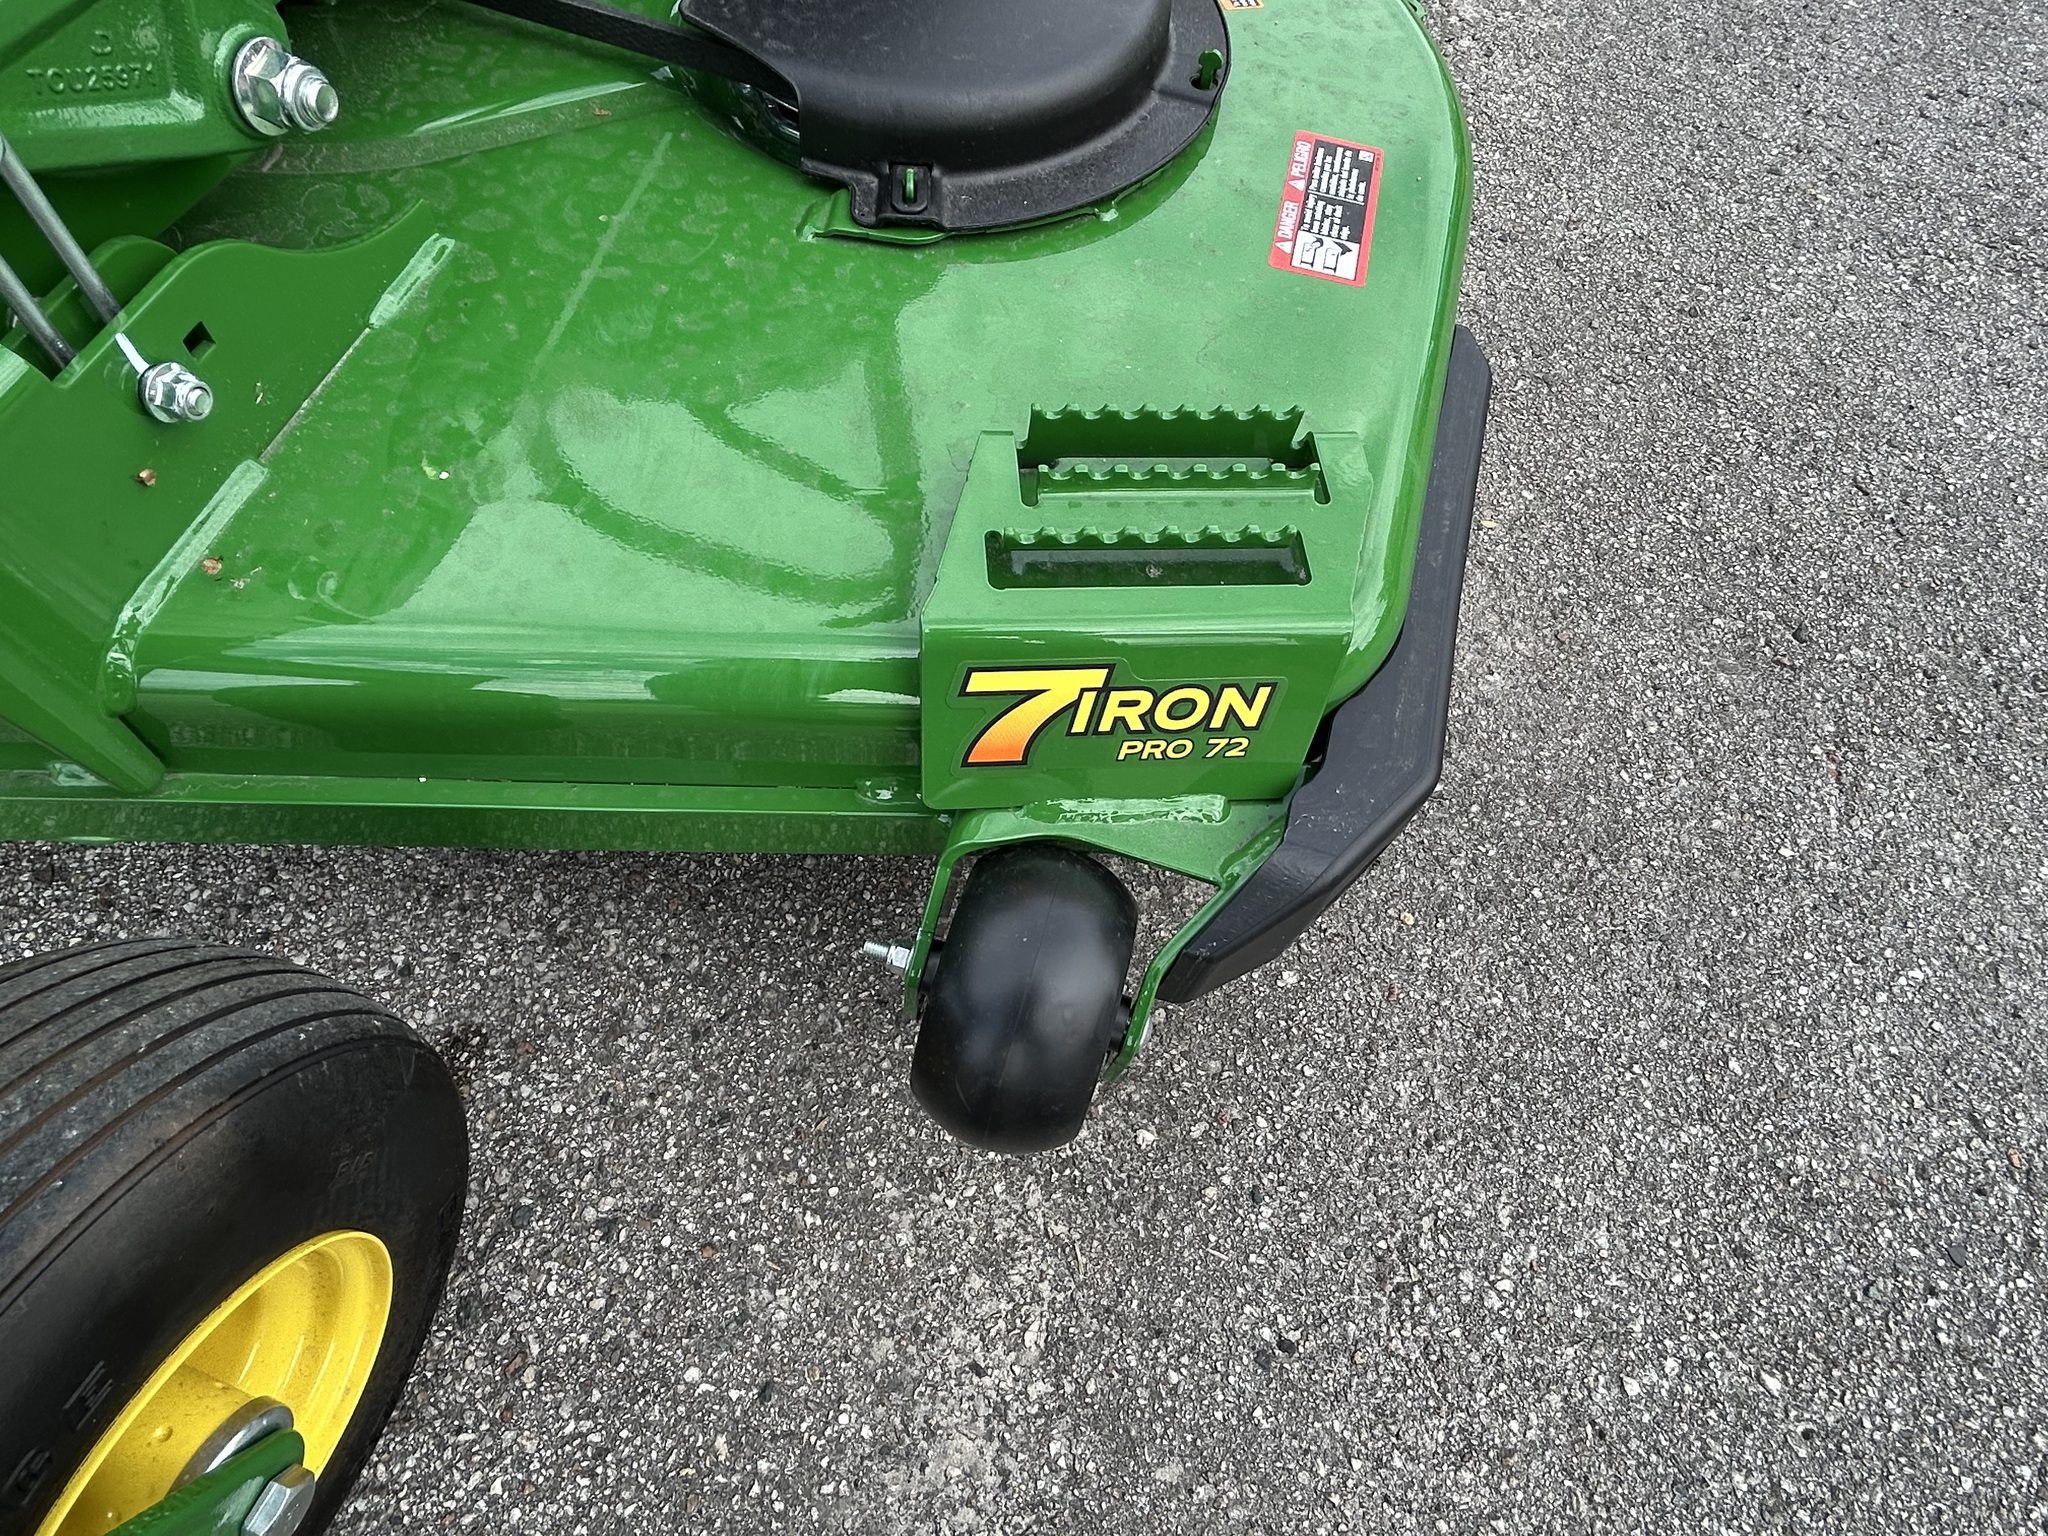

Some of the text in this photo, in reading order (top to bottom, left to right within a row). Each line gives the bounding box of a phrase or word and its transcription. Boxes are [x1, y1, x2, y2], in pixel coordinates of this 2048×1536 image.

[1290, 140, 1311, 178] PELIGRO
[1277, 200, 1299, 239] DANGER
[1116, 737, 1249, 761] PRO 72
